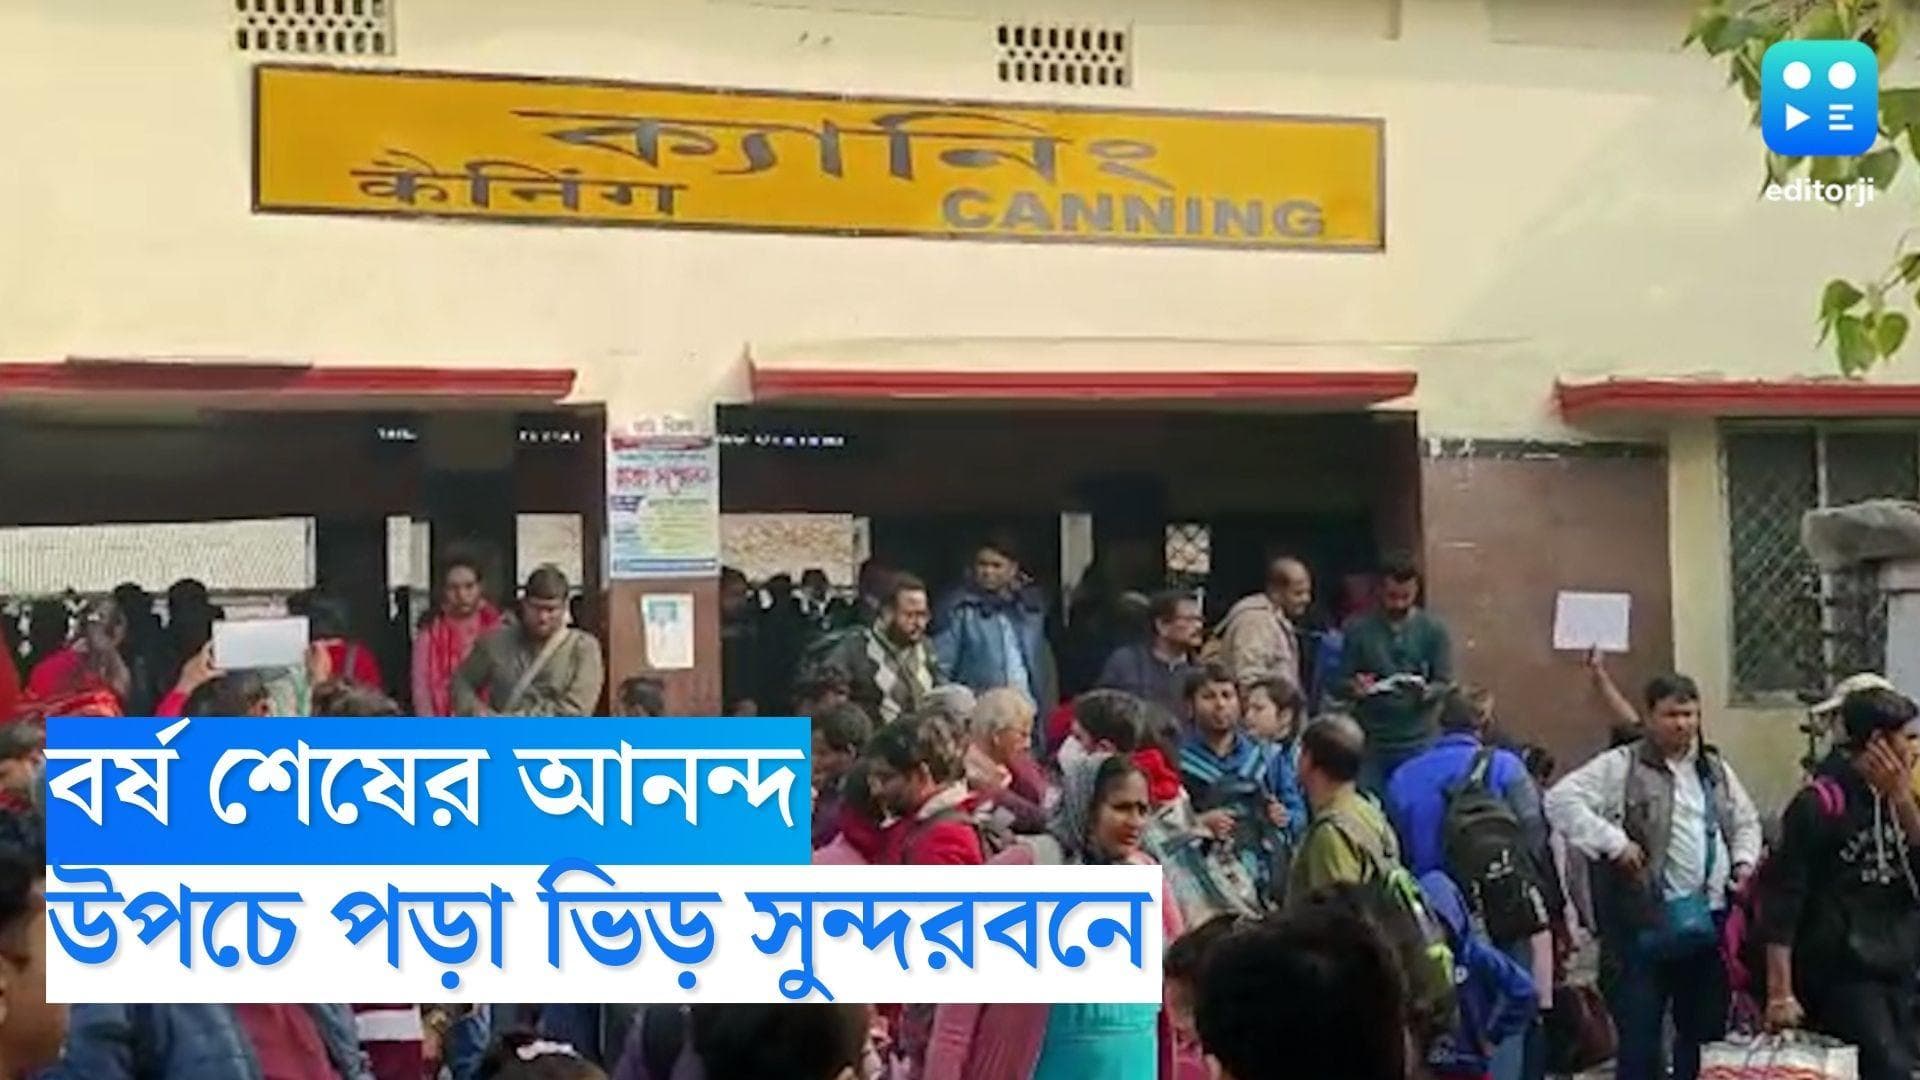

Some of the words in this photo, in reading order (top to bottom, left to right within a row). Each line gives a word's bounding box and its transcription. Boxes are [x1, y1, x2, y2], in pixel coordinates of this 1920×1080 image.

[349, 148, 689, 215] कैनिंग
[512, 110, 1174, 190] ক্যানিং
[941, 188, 1326, 238] CANNING
